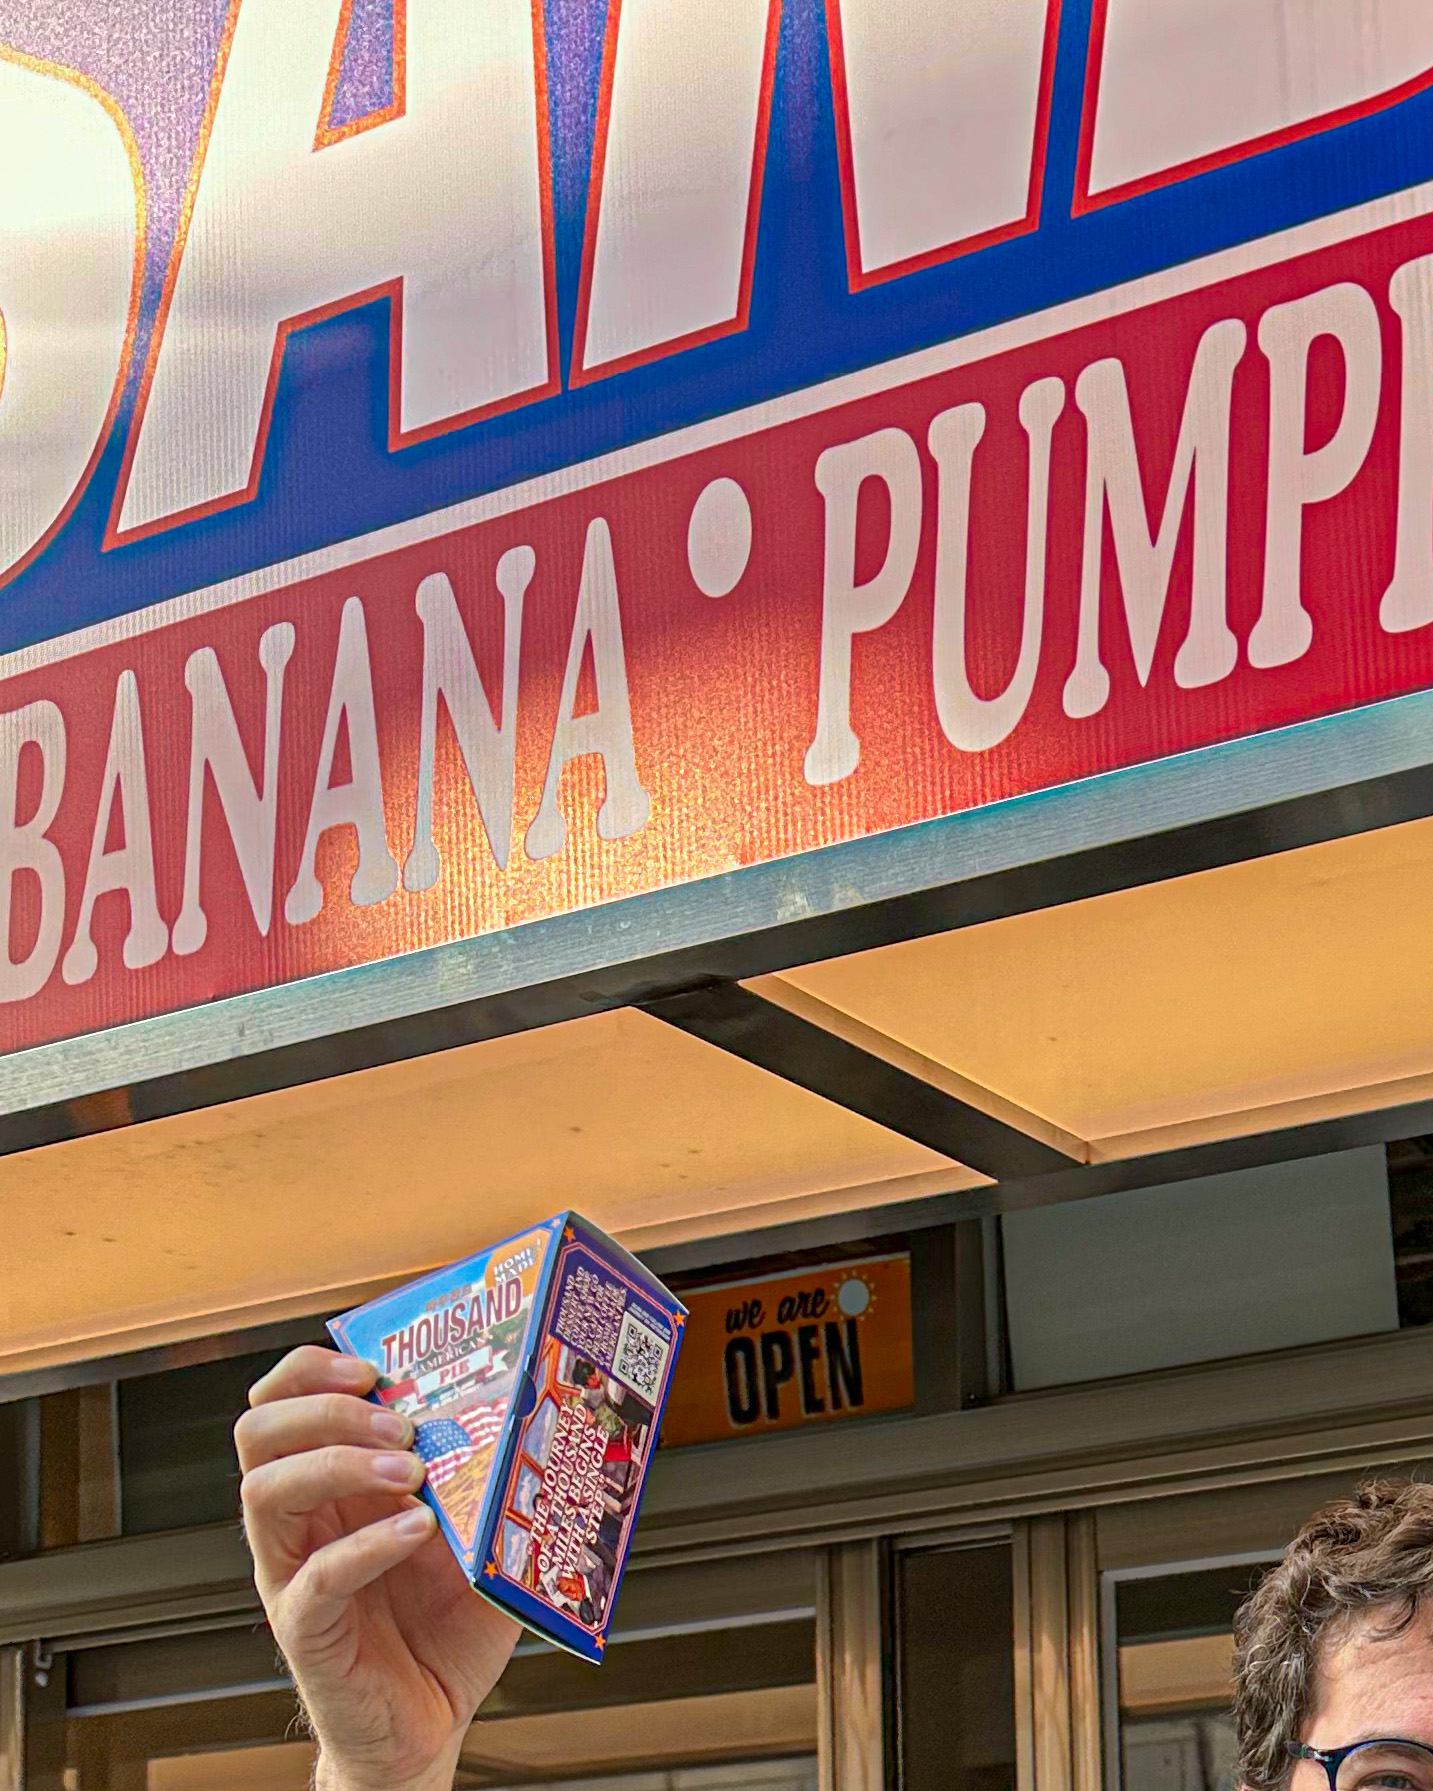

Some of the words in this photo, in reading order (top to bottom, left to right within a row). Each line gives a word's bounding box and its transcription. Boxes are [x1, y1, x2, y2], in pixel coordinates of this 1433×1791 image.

[0, 517, 650, 1000] BANANA
[382, 1278, 521, 1374] THOUSAND
[726, 1299, 766, 1333] we
[777, 1288, 830, 1324] are
[439, 1359, 470, 1385] PIE
[725, 1318, 864, 1427] OPEN
[542, 1398, 574, 1499] JOURNEY
[551, 1403, 586, 1518] THOUSAND
[582, 1424, 610, 1504] SINGLE
[546, 1523, 559, 1540] A
[552, 1503, 577, 1567] MILES
[568, 1423, 596, 1503] BEGINS
[577, 1505, 590, 1523] A
[537, 1540, 554, 1573] OF
[562, 1522, 585, 1579] WITH
